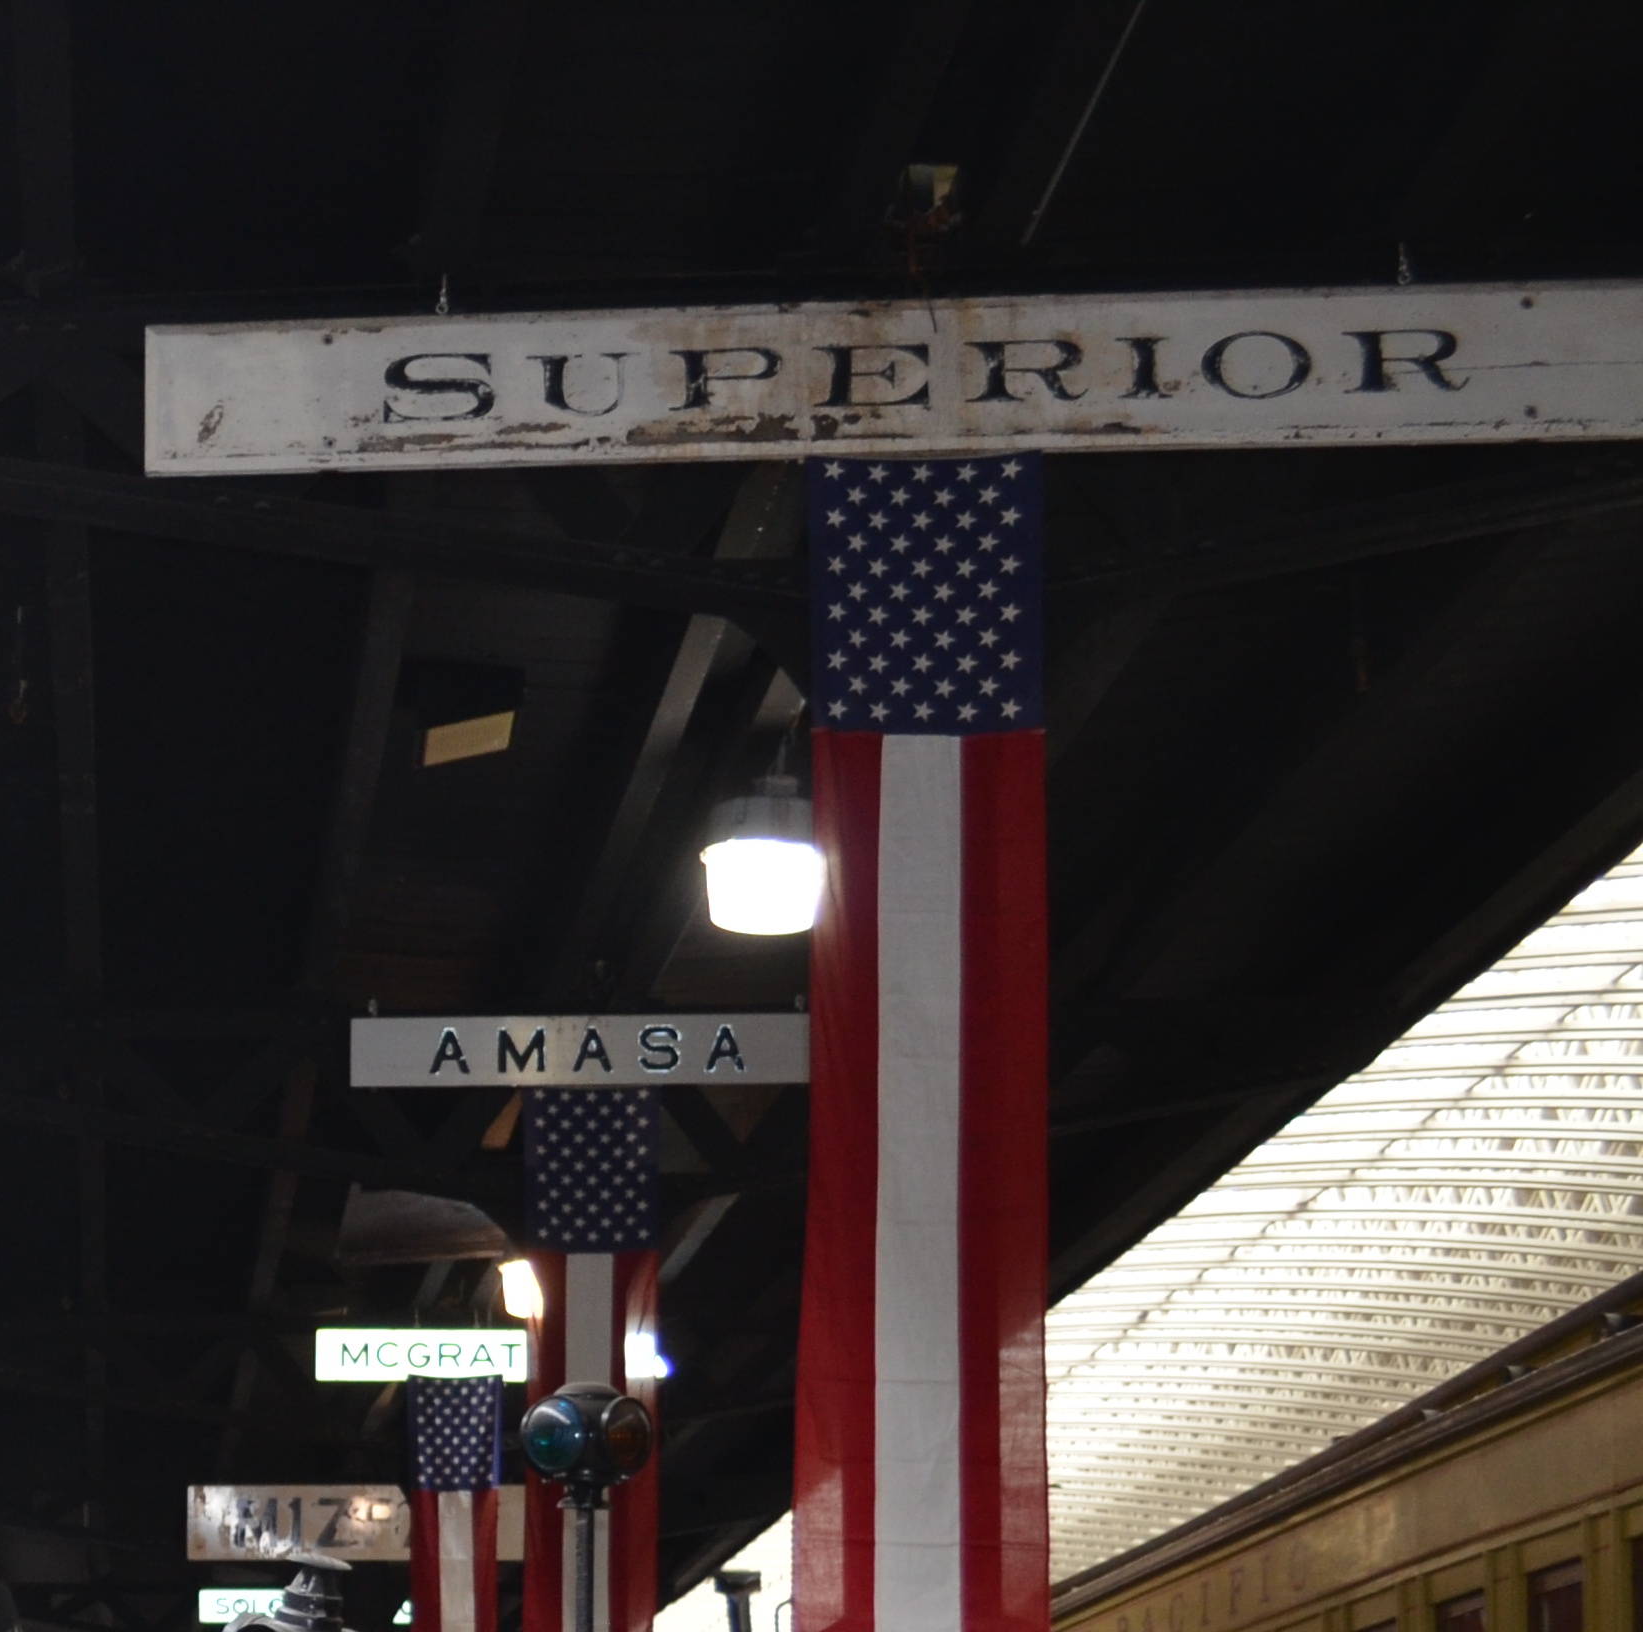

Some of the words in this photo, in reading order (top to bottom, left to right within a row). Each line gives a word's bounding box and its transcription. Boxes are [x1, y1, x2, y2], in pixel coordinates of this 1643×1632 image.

[384, 327, 1468, 426] SUPERIOR
[429, 1023, 746, 1075] AMASA
[340, 1342, 522, 1369] MCGRAT
